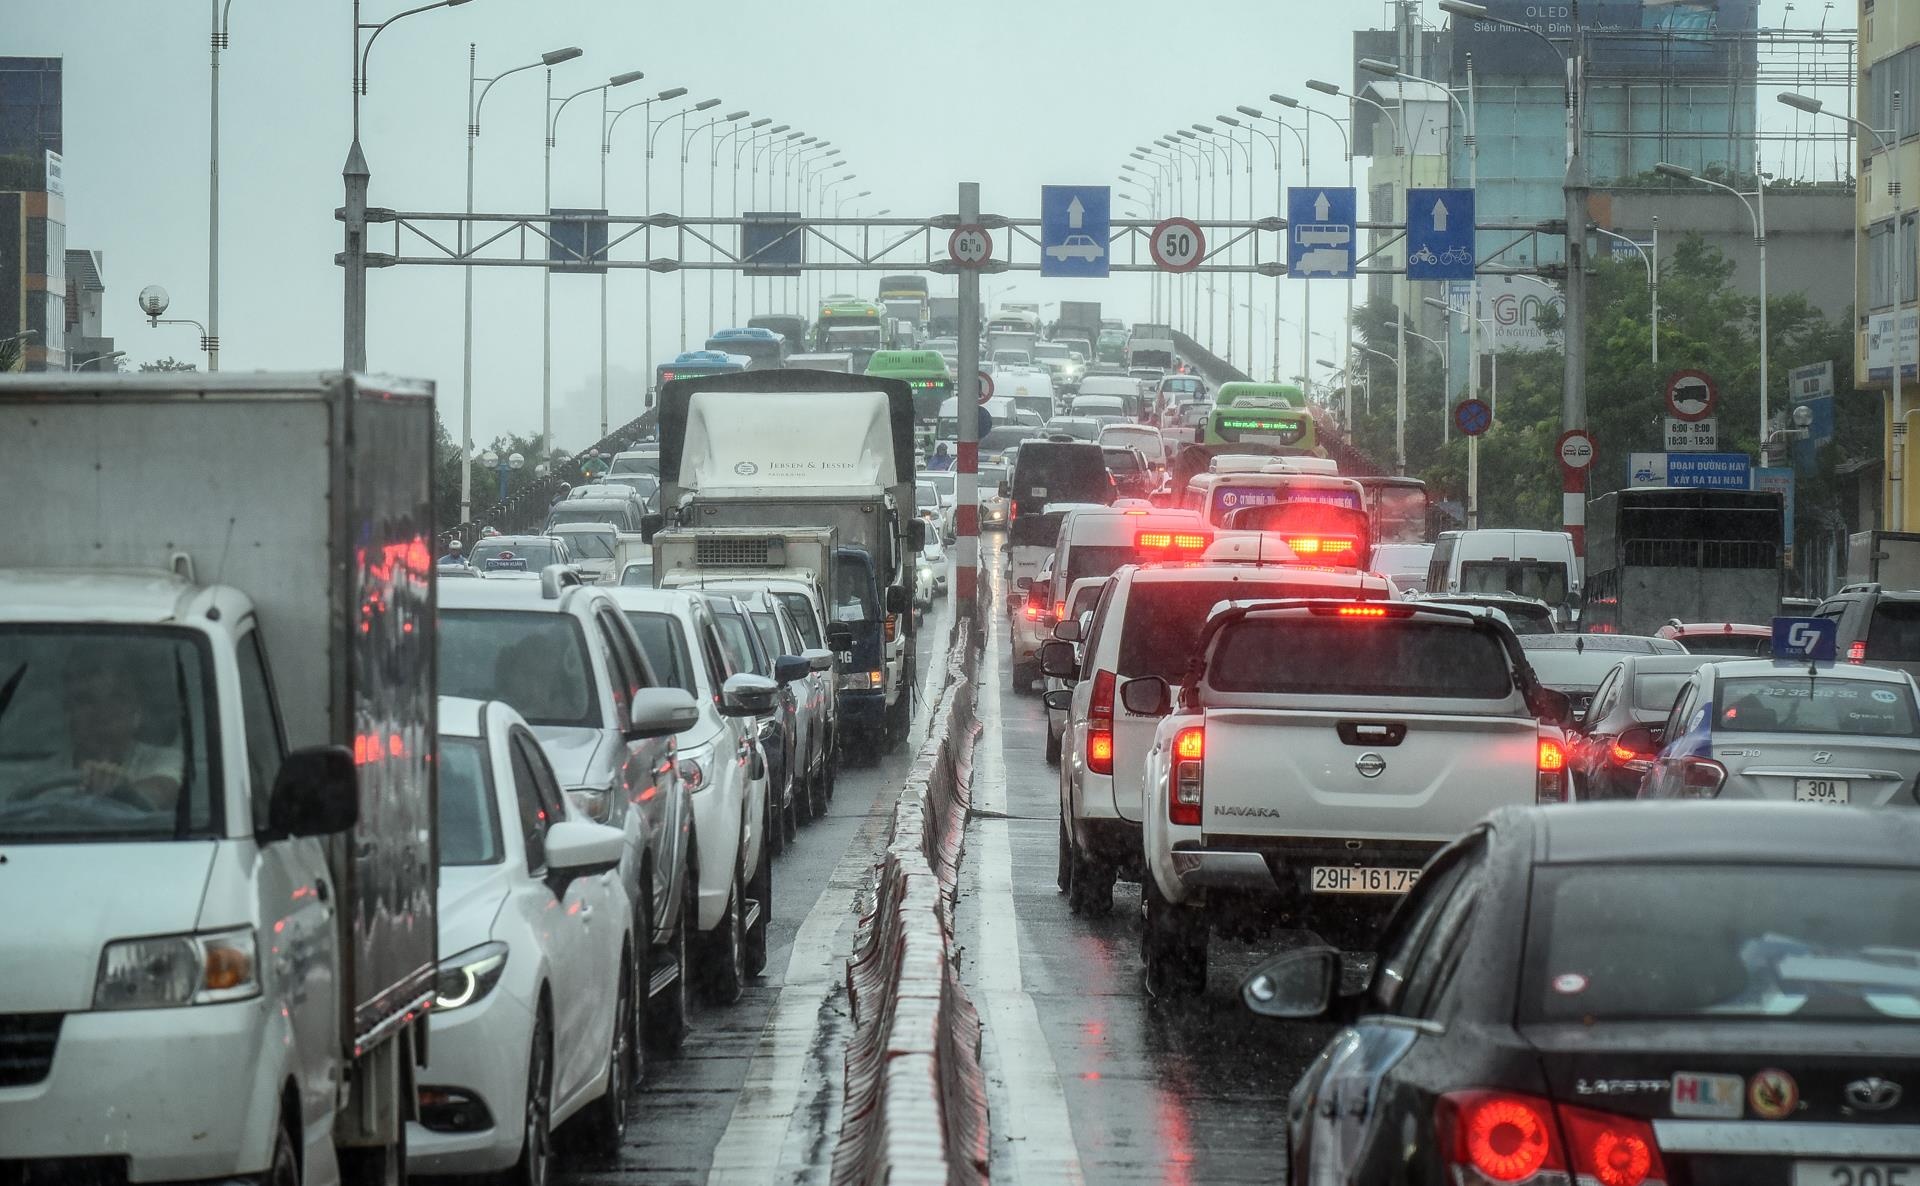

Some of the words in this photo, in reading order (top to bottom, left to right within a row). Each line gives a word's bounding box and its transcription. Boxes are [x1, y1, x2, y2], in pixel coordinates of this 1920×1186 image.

[1526, 6, 1569, 18] OLED
[1166, 233, 1190, 257] 50
[1668, 436, 1687, 446] 16:30
[808, 461, 816, 469] &
[1729, 462, 1746, 471] HAY
[1692, 475, 1705, 484] RA
[1224, 494, 1236, 505] 40
[1788, 622, 1821, 655] G7
[1808, 780, 1836, 798] 30A
[1214, 805, 1280, 818] NAVARA
[1316, 868, 1420, 890] 29H-161.75
